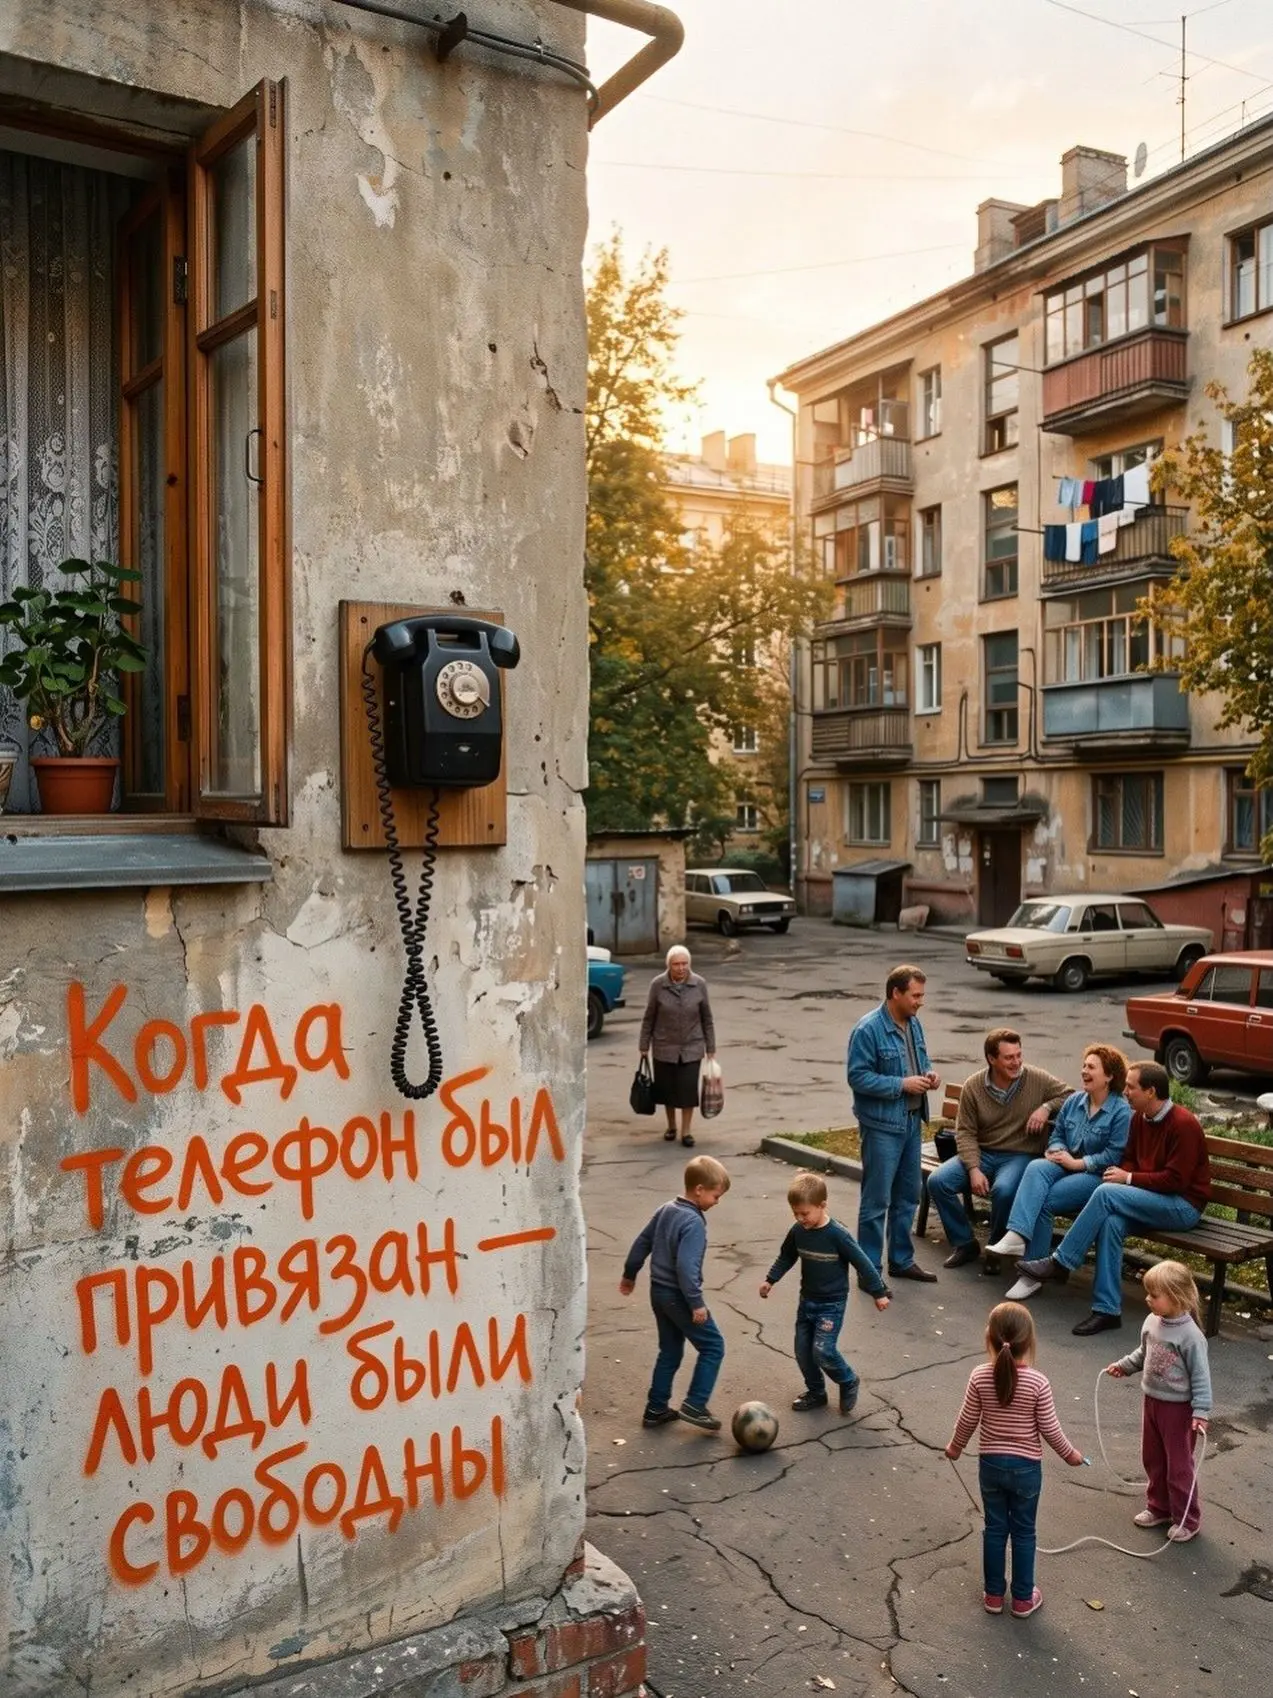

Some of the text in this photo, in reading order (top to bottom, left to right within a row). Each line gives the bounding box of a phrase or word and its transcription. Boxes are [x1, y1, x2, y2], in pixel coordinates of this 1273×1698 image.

[64, 981, 352, 1117] Когда
[59, 1065, 566, 1231] телефон был
[74, 1216, 558, 1379] привязан —
[82, 1312, 534, 1479] люди были
[106, 1414, 508, 1590] свободны
